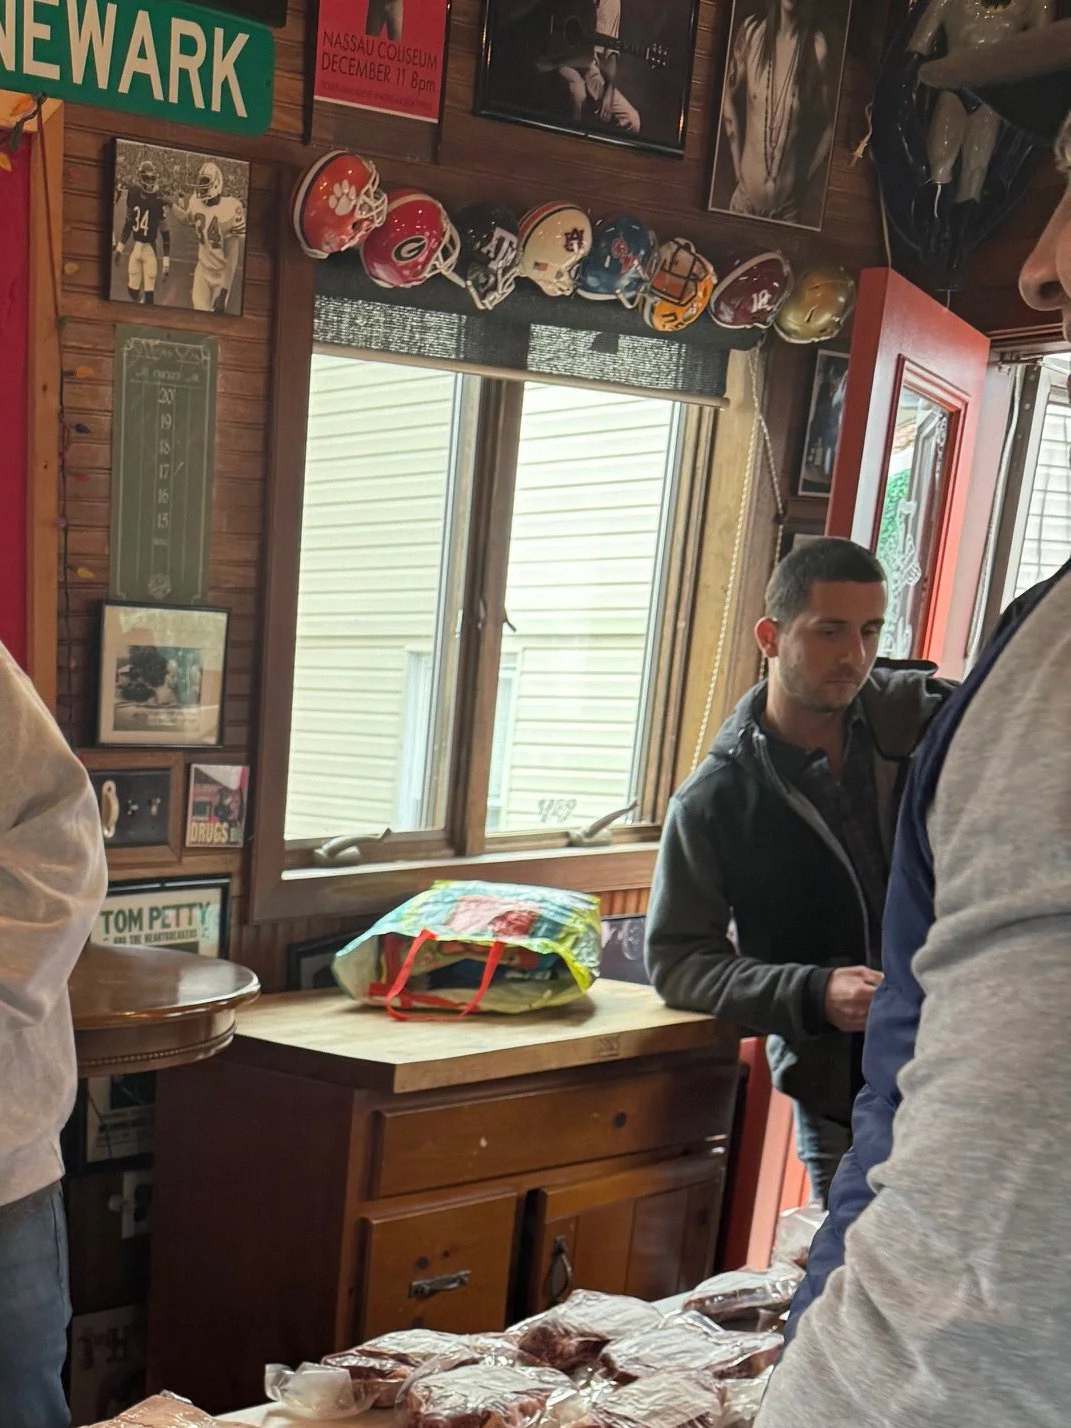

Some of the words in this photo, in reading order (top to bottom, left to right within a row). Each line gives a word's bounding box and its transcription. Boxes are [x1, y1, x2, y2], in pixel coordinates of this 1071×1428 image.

[323, 31, 375, 56] NASSAU
[377, 41, 438, 70] COLISEUM
[321, 52, 391, 83] DECEMBER
[396, 67, 407, 87] 11
[410, 70, 436, 95] 8pm
[132, 206, 150, 237] 34
[161, 413, 173, 430] 19
[159, 463, 170, 480] 17
[157, 488, 169, 505] 16
[157, 512, 169, 529] 15
[190, 821, 228, 844] DRUGS
[99, 907, 144, 935] TOM
[148, 901, 210, 930] PETTY
[144, 929, 198, 943] HEARTBREAKERS
